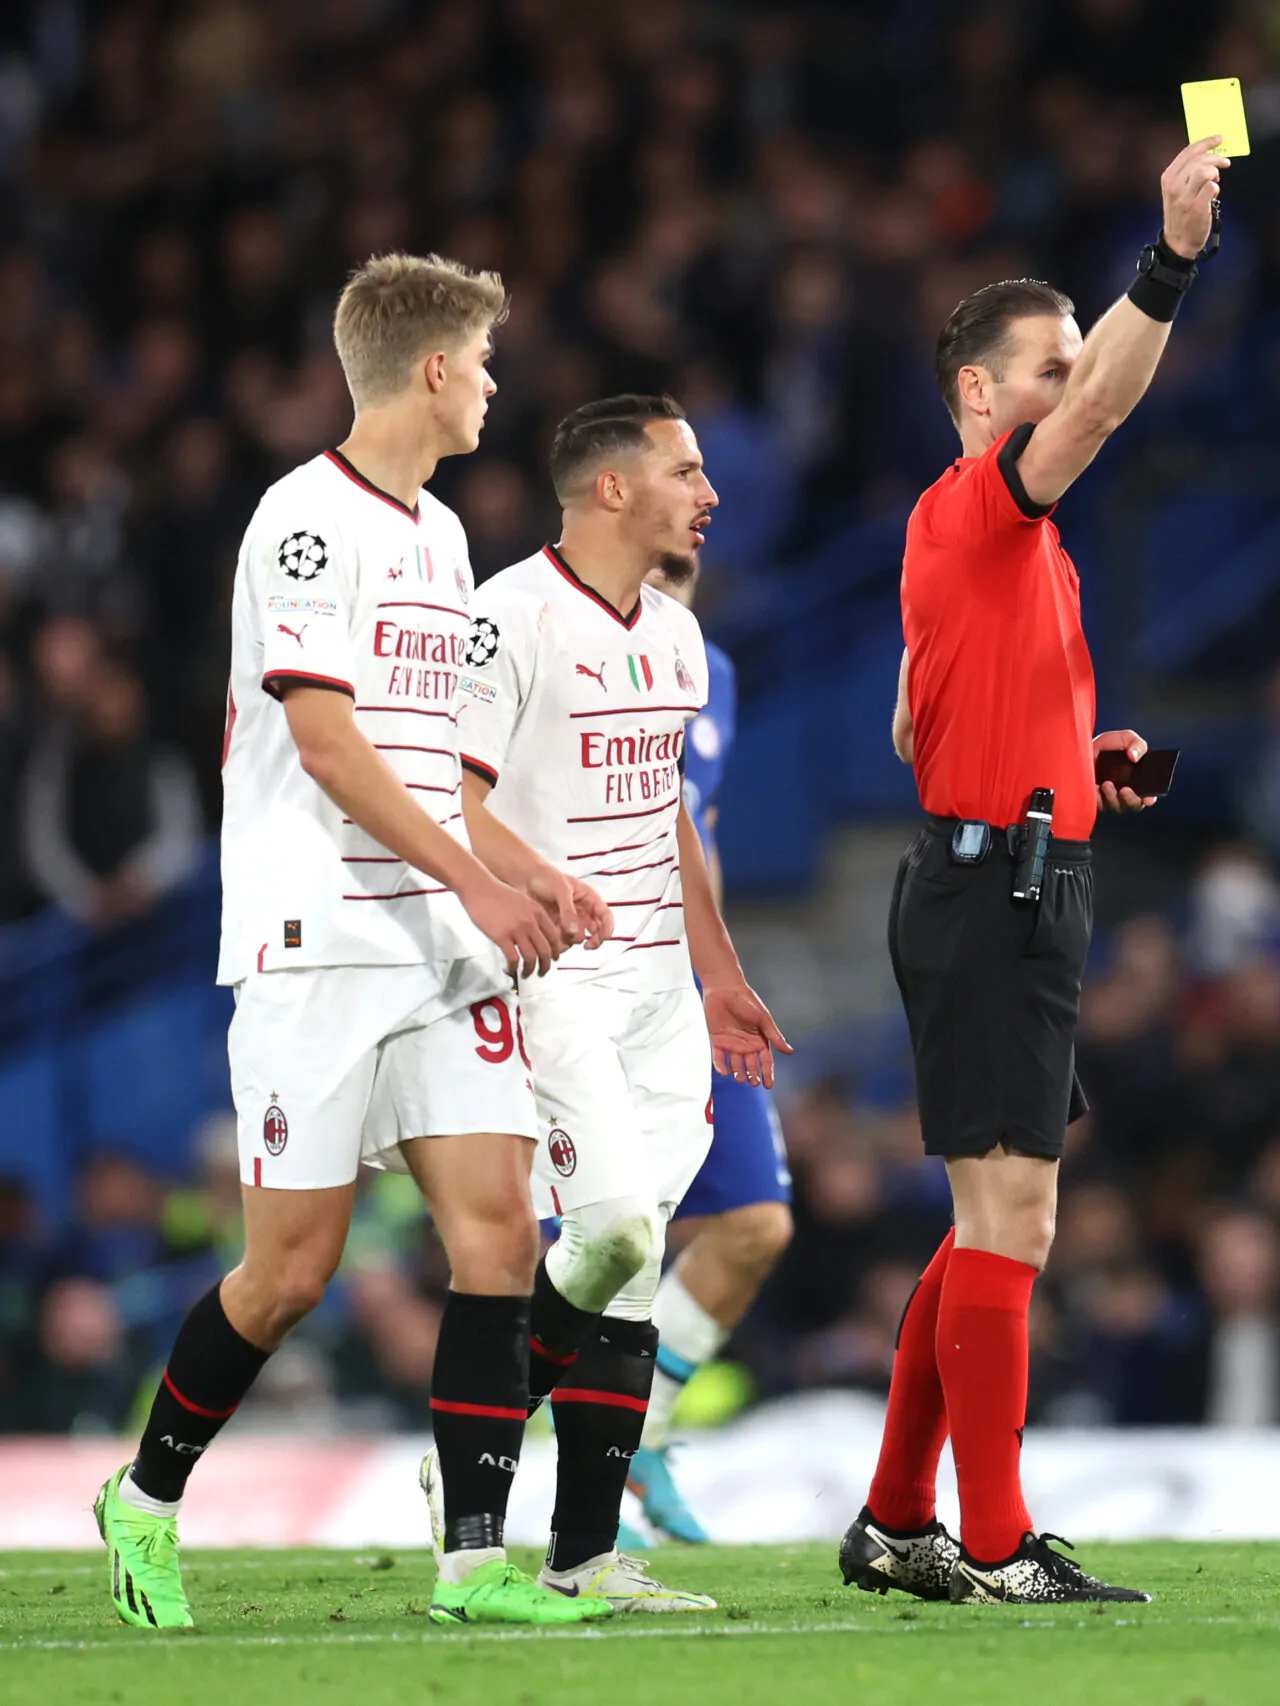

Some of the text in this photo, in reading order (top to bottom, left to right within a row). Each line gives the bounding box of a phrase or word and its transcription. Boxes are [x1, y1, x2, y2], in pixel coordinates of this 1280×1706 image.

[373, 620, 465, 668] Emirate
[388, 665, 458, 701] FLY BETT
[580, 727, 684, 768] Emirat
[606, 762, 676, 804] FLY BETE
[606, 1445, 640, 1459] AC
